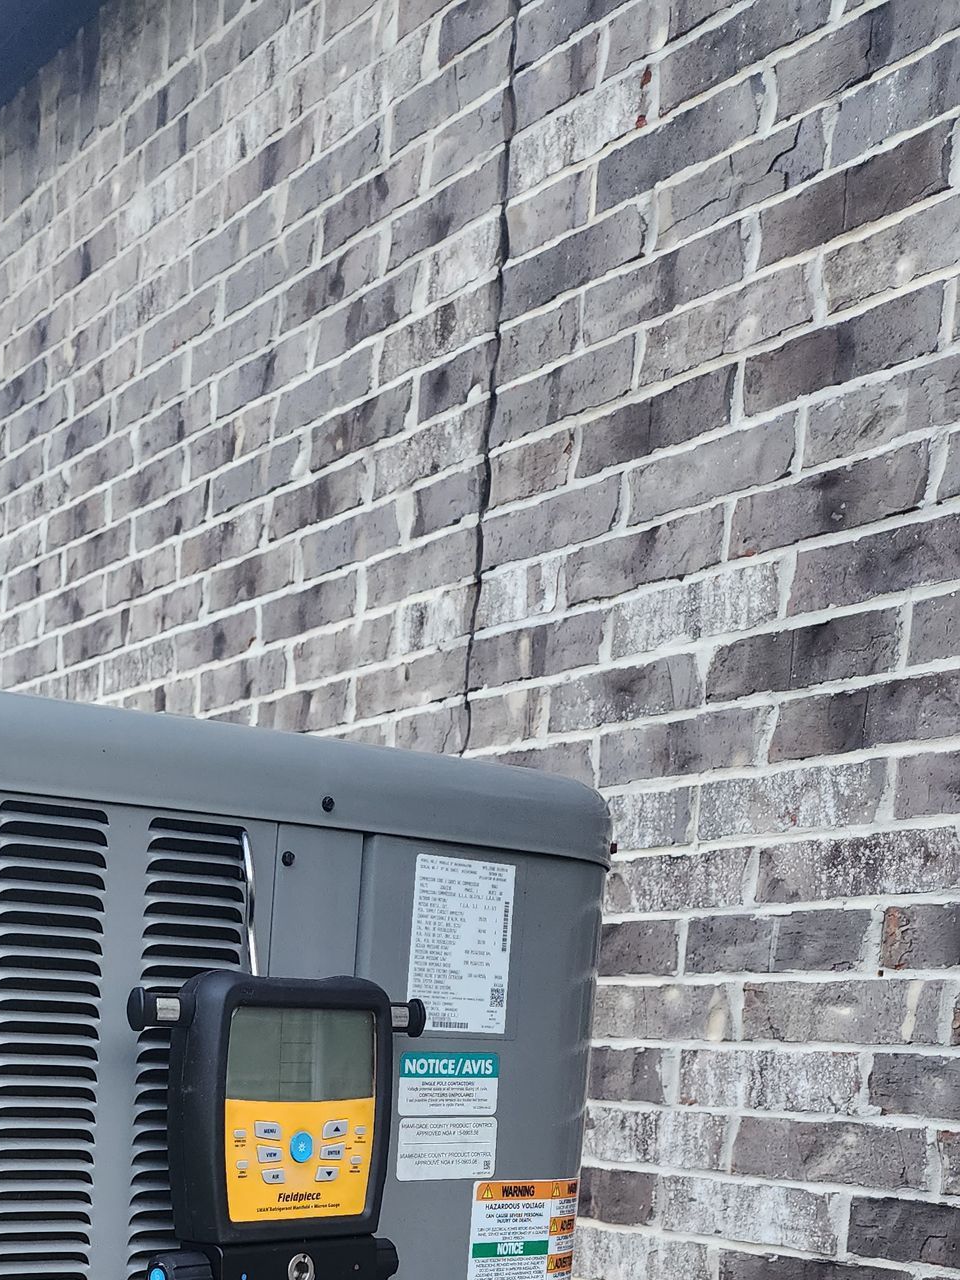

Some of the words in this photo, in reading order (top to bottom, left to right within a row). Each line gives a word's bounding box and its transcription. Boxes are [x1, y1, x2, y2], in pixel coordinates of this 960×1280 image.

[404, 1058, 493, 1075] NOTICE/AVIS
[501, 1185, 535, 1197] WARNING
[277, 1192, 321, 1203] Fieldpiece
[485, 1202, 520, 1210] HAZARDOUS
[496, 1242, 524, 1255] NOTICE
